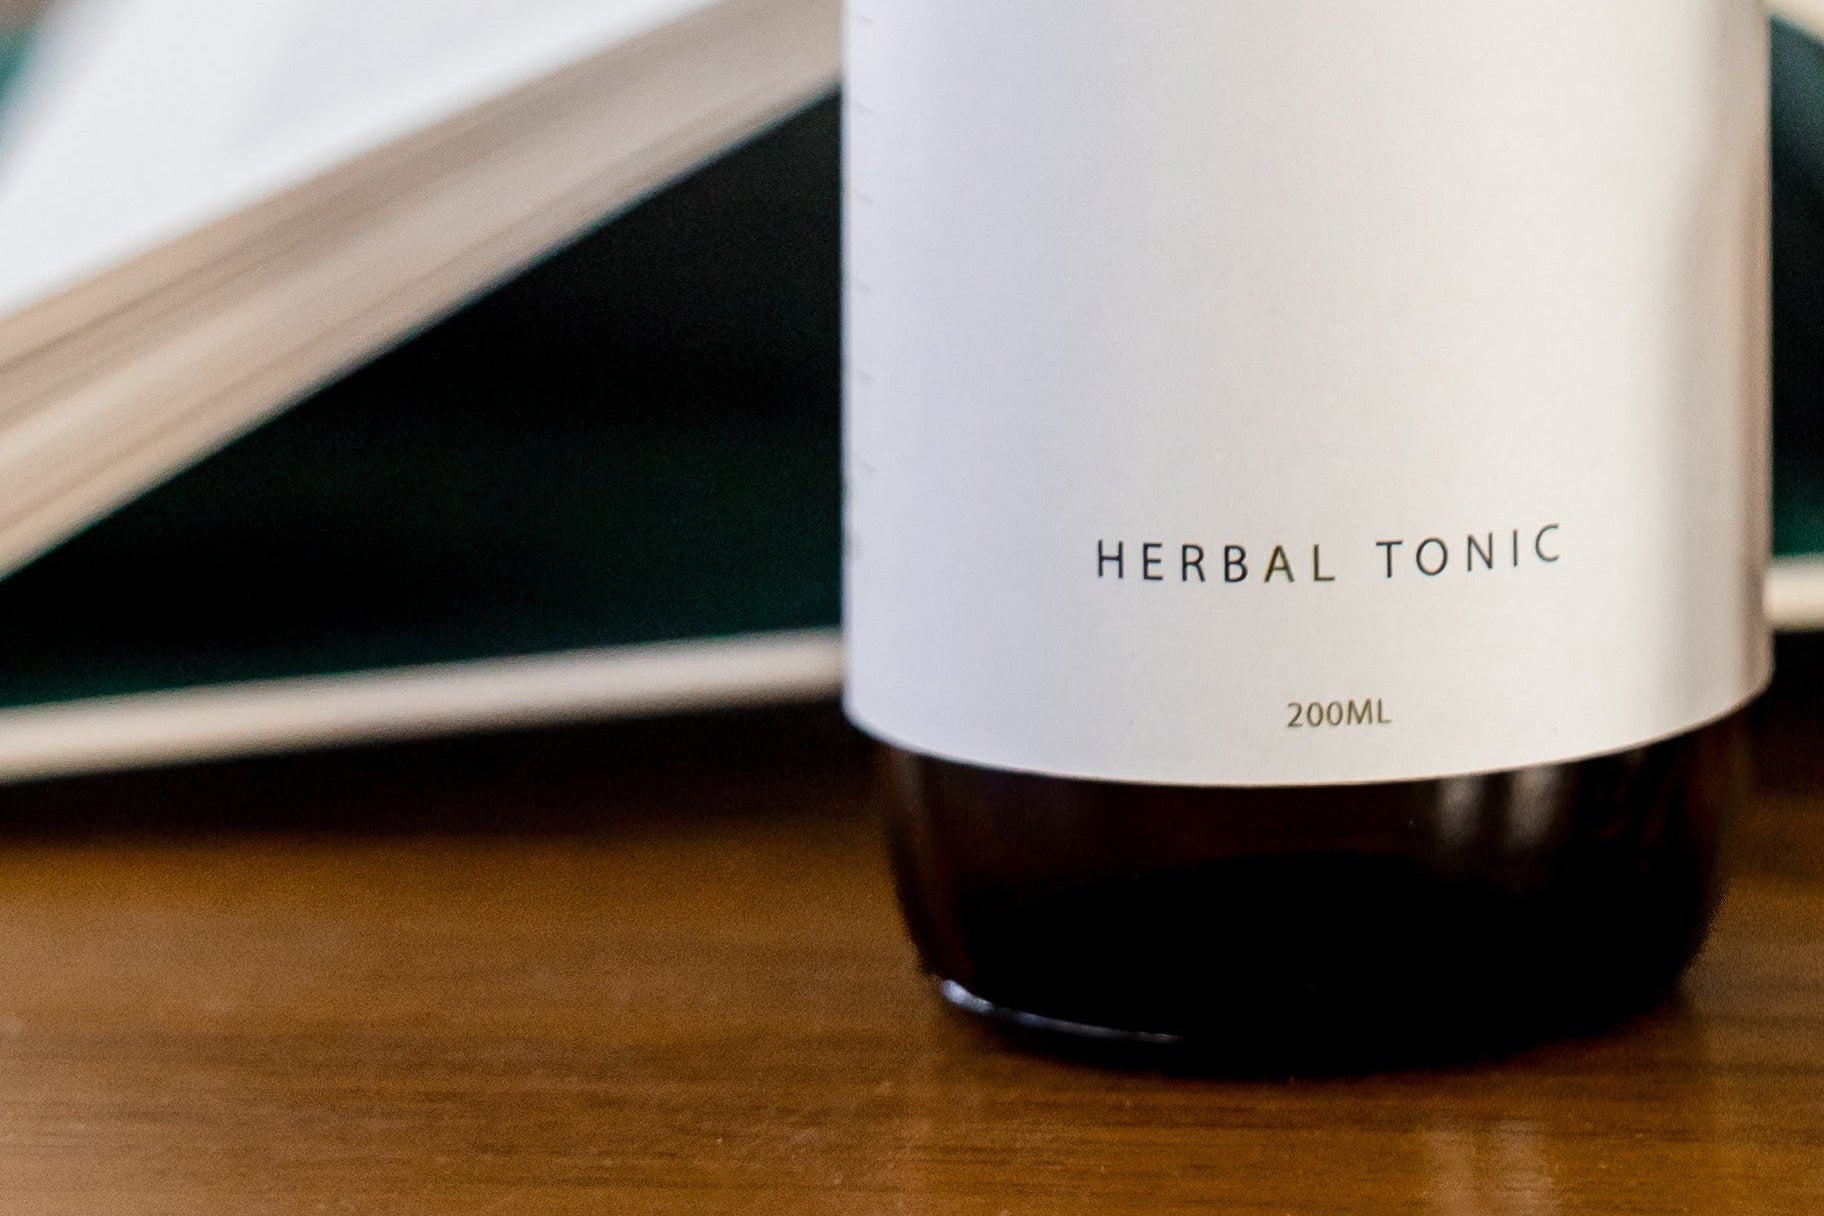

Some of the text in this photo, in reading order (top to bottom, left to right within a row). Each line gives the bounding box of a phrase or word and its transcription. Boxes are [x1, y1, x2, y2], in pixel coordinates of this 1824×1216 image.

[1096, 522, 1561, 584] HERBAL TONIC
[1286, 697, 1393, 729] 200ML
